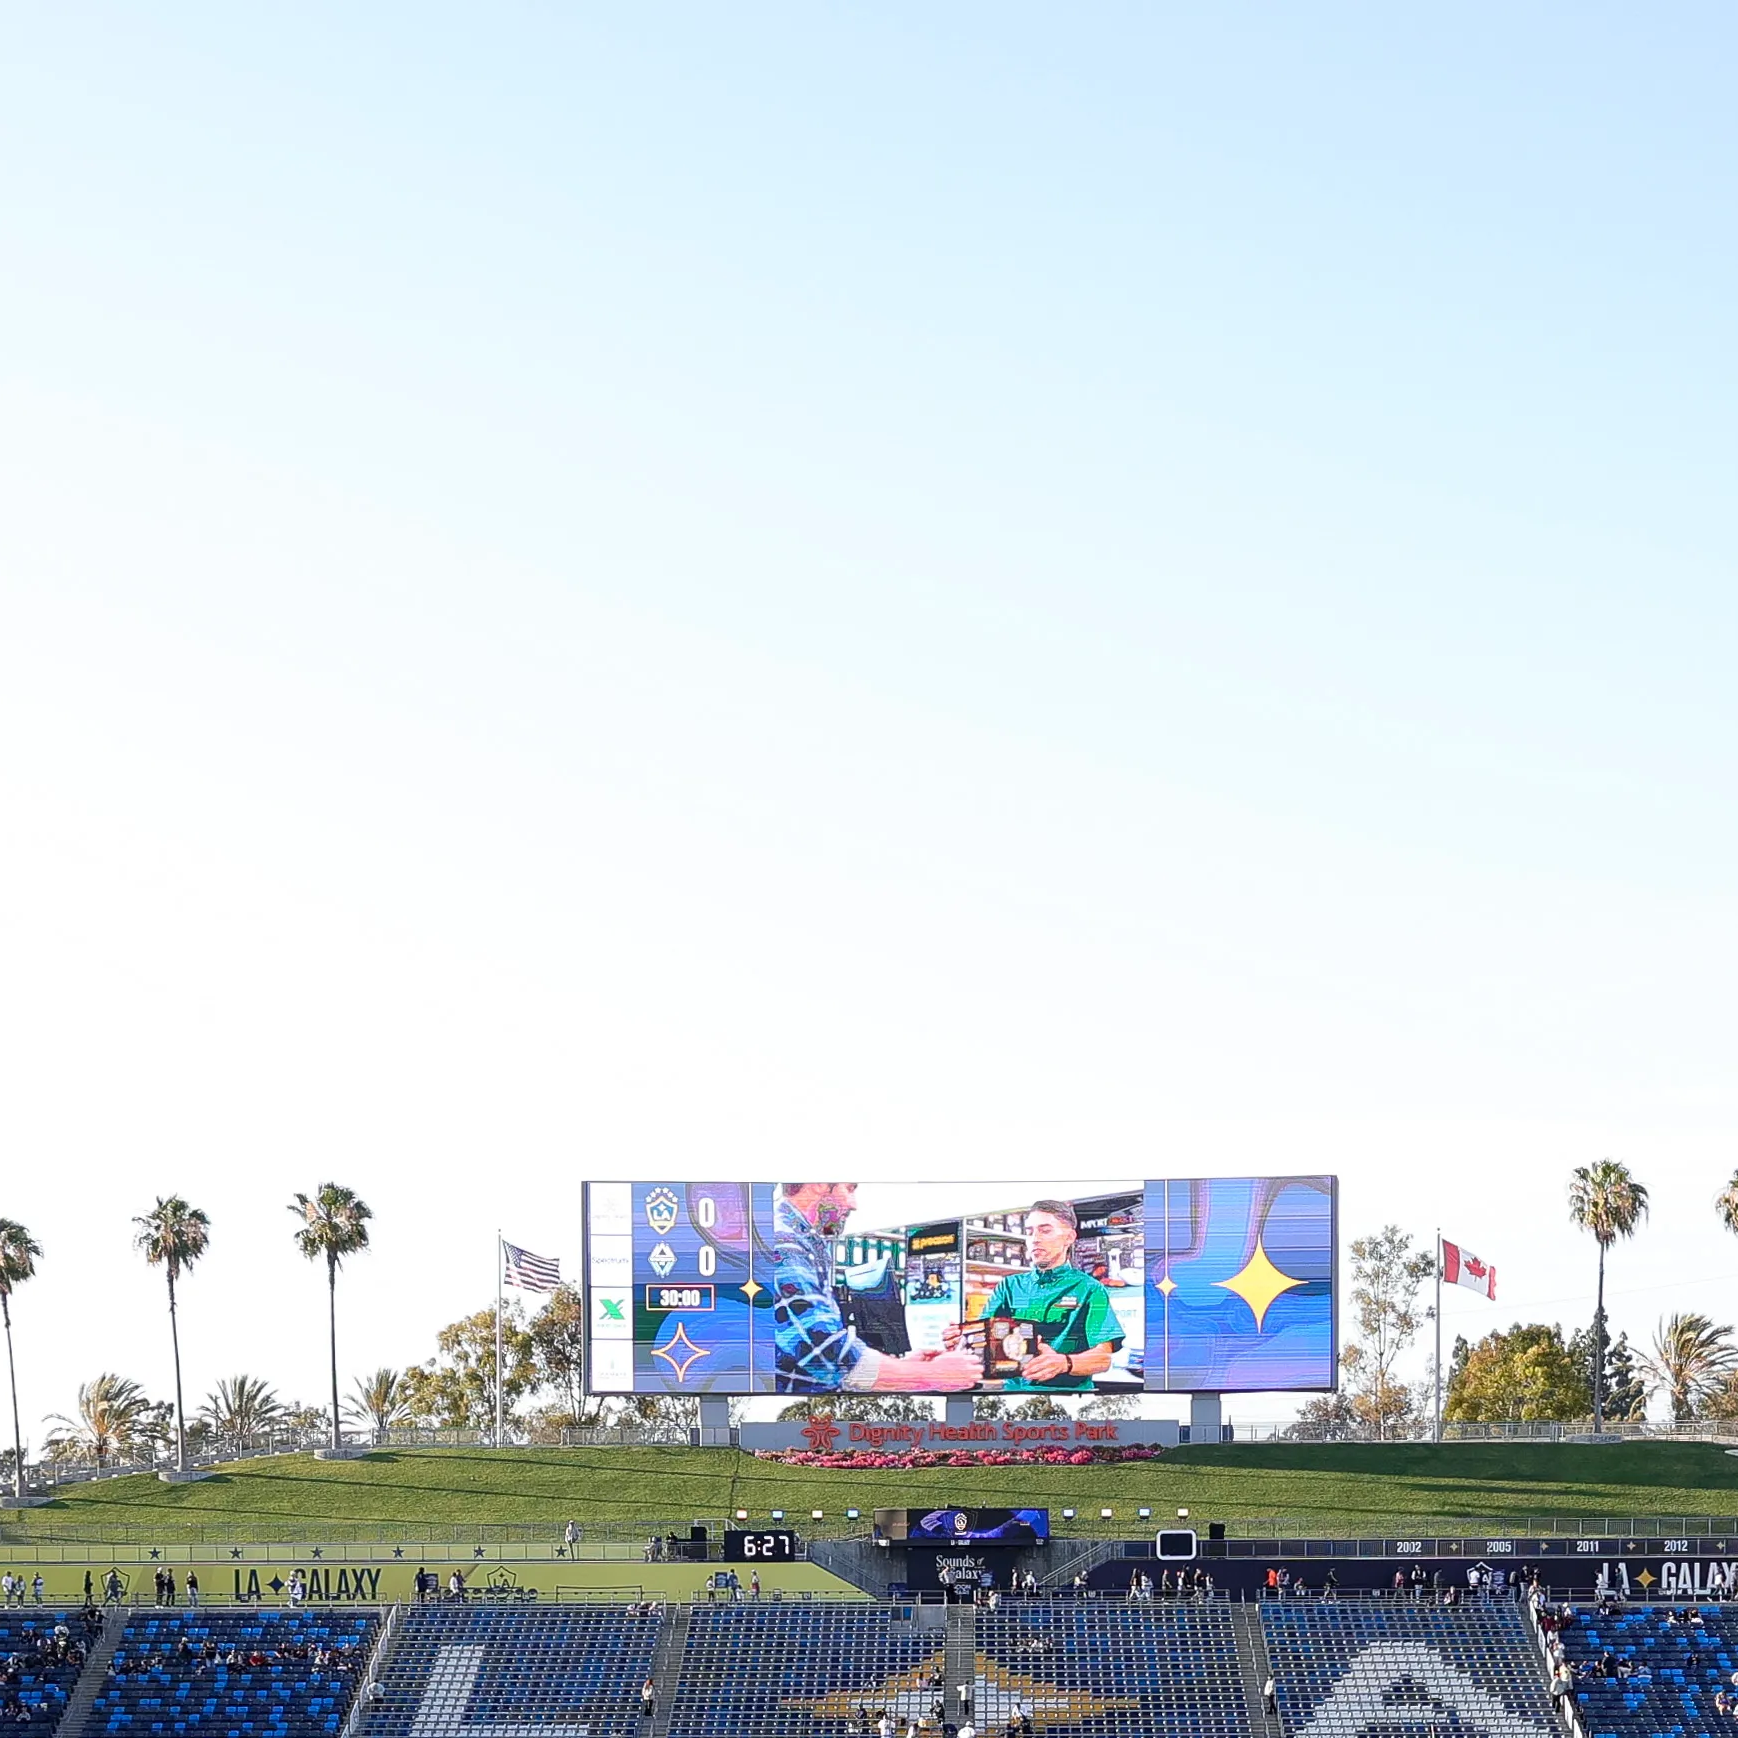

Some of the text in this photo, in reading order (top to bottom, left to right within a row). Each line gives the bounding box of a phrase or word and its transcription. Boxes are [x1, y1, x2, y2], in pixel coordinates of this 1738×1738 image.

[653, 1209, 670, 1221] LA
[698, 1198, 715, 1228] 0
[699, 1245, 716, 1276] 0
[660, 1290, 700, 1306] 30:00
[849, 1420, 1118, 1446] Dignity Health Sports Park
[744, 1535, 789, 1555] 6:27
[1396, 1542, 1422, 1553] 2002
[1486, 1541, 1512, 1553] 2005
[1576, 1541, 1599, 1552] 2011
[1664, 1540, 1688, 1552] 2012
[936, 1555, 984, 1568] Sounds of
[234, 1568, 262, 1601] LA
[1602, 1562, 1629, 1595] LA
